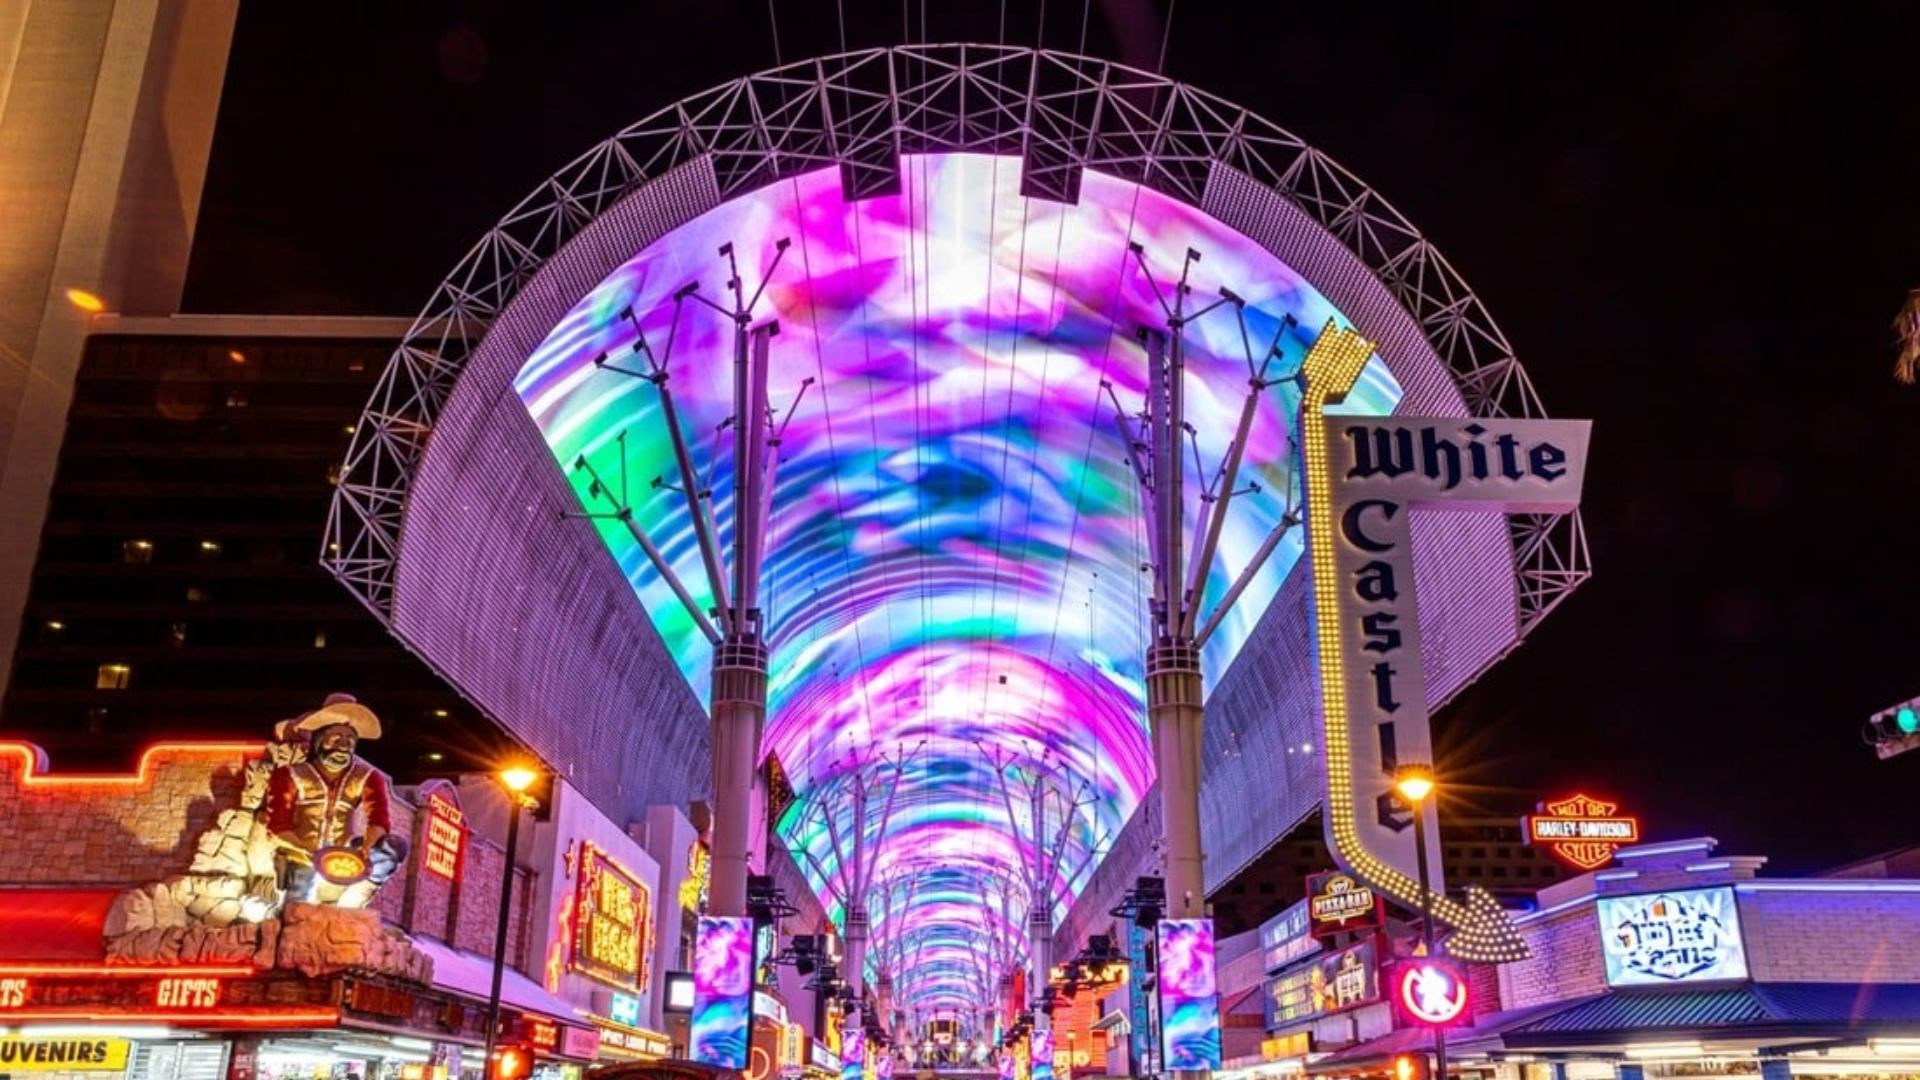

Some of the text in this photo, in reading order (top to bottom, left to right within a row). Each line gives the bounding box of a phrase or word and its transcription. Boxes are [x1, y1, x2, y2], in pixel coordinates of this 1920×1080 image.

[1345, 423, 1567, 491] White
[1340, 499, 1414, 834] Castle
[1557, 801, 1607, 816] MOTOR
[1536, 821, 1631, 837] HARLEY-DAVIDSON
[1562, 842, 1611, 863] CYCLES
[157, 979, 219, 1007] GIFTS
[0, 1041, 108, 1063] UVENIRS
